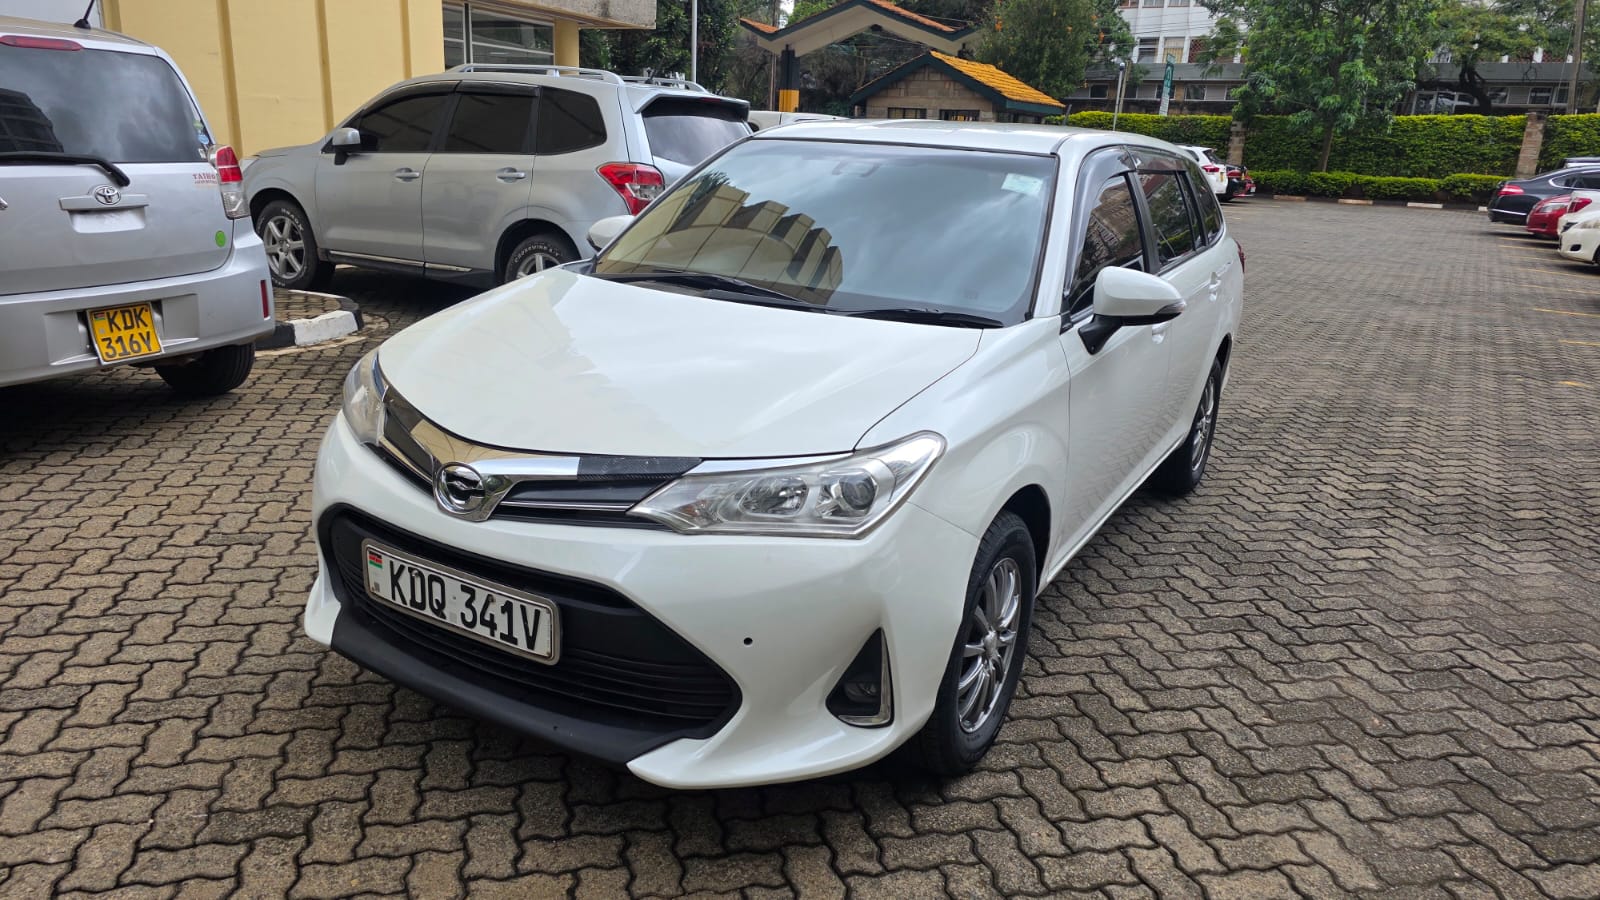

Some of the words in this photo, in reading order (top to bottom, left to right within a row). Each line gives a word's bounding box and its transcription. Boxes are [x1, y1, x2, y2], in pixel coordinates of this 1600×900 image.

[106, 306, 149, 333] KDK
[101, 331, 152, 359] 316Y
[389, 560, 447, 619] KDQ
[460, 584, 541, 650] 341V
